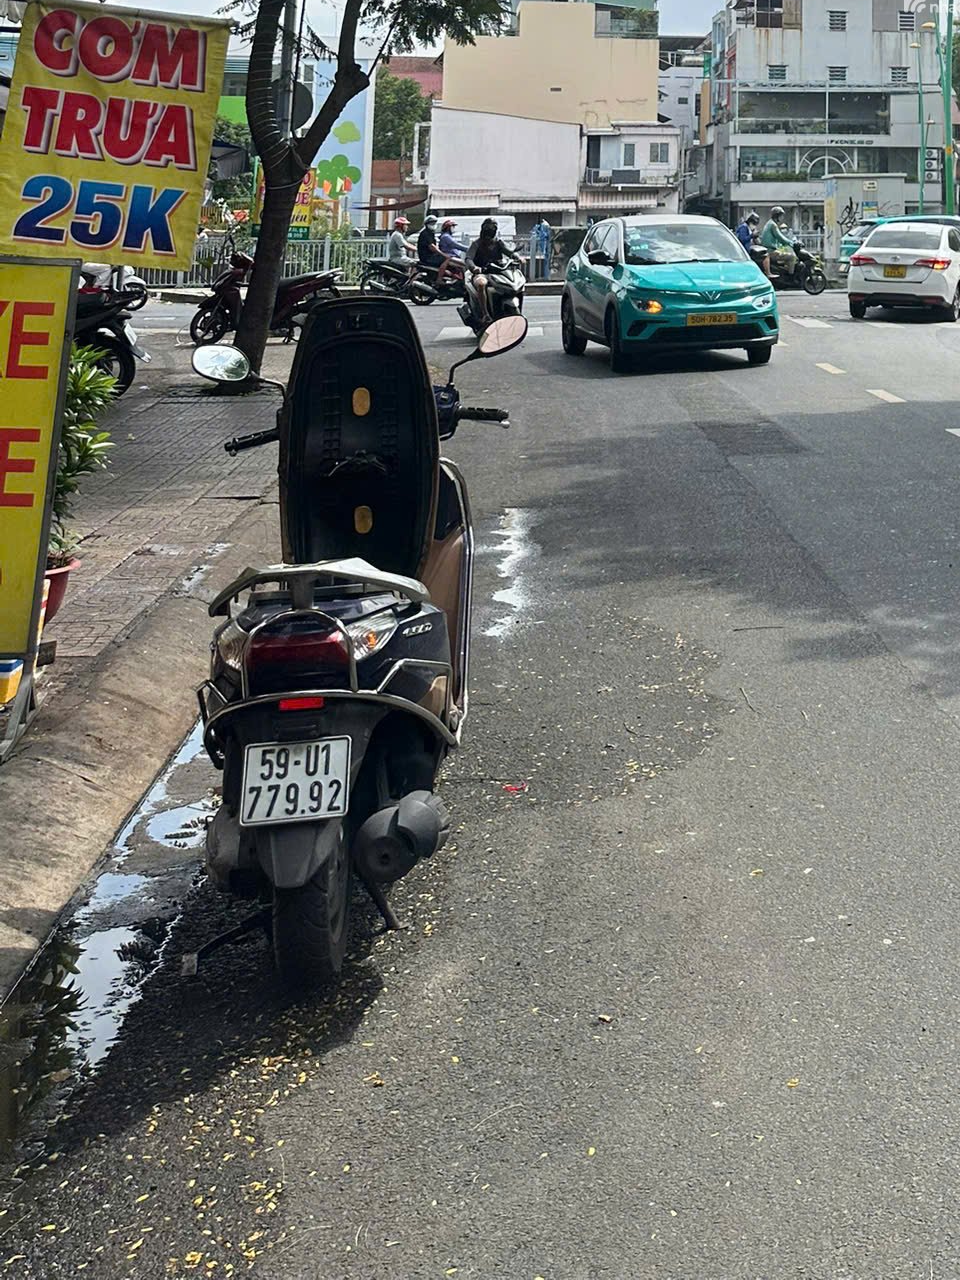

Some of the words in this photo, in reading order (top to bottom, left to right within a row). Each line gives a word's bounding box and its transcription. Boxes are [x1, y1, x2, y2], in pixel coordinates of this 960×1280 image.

[34, 9, 207, 93] CƠM
[21, 86, 197, 171] TRƯA
[11, 175, 188, 257] 25K
[247, 779, 342, 820] 779.92
[260, 743, 331, 781] 59-U1
